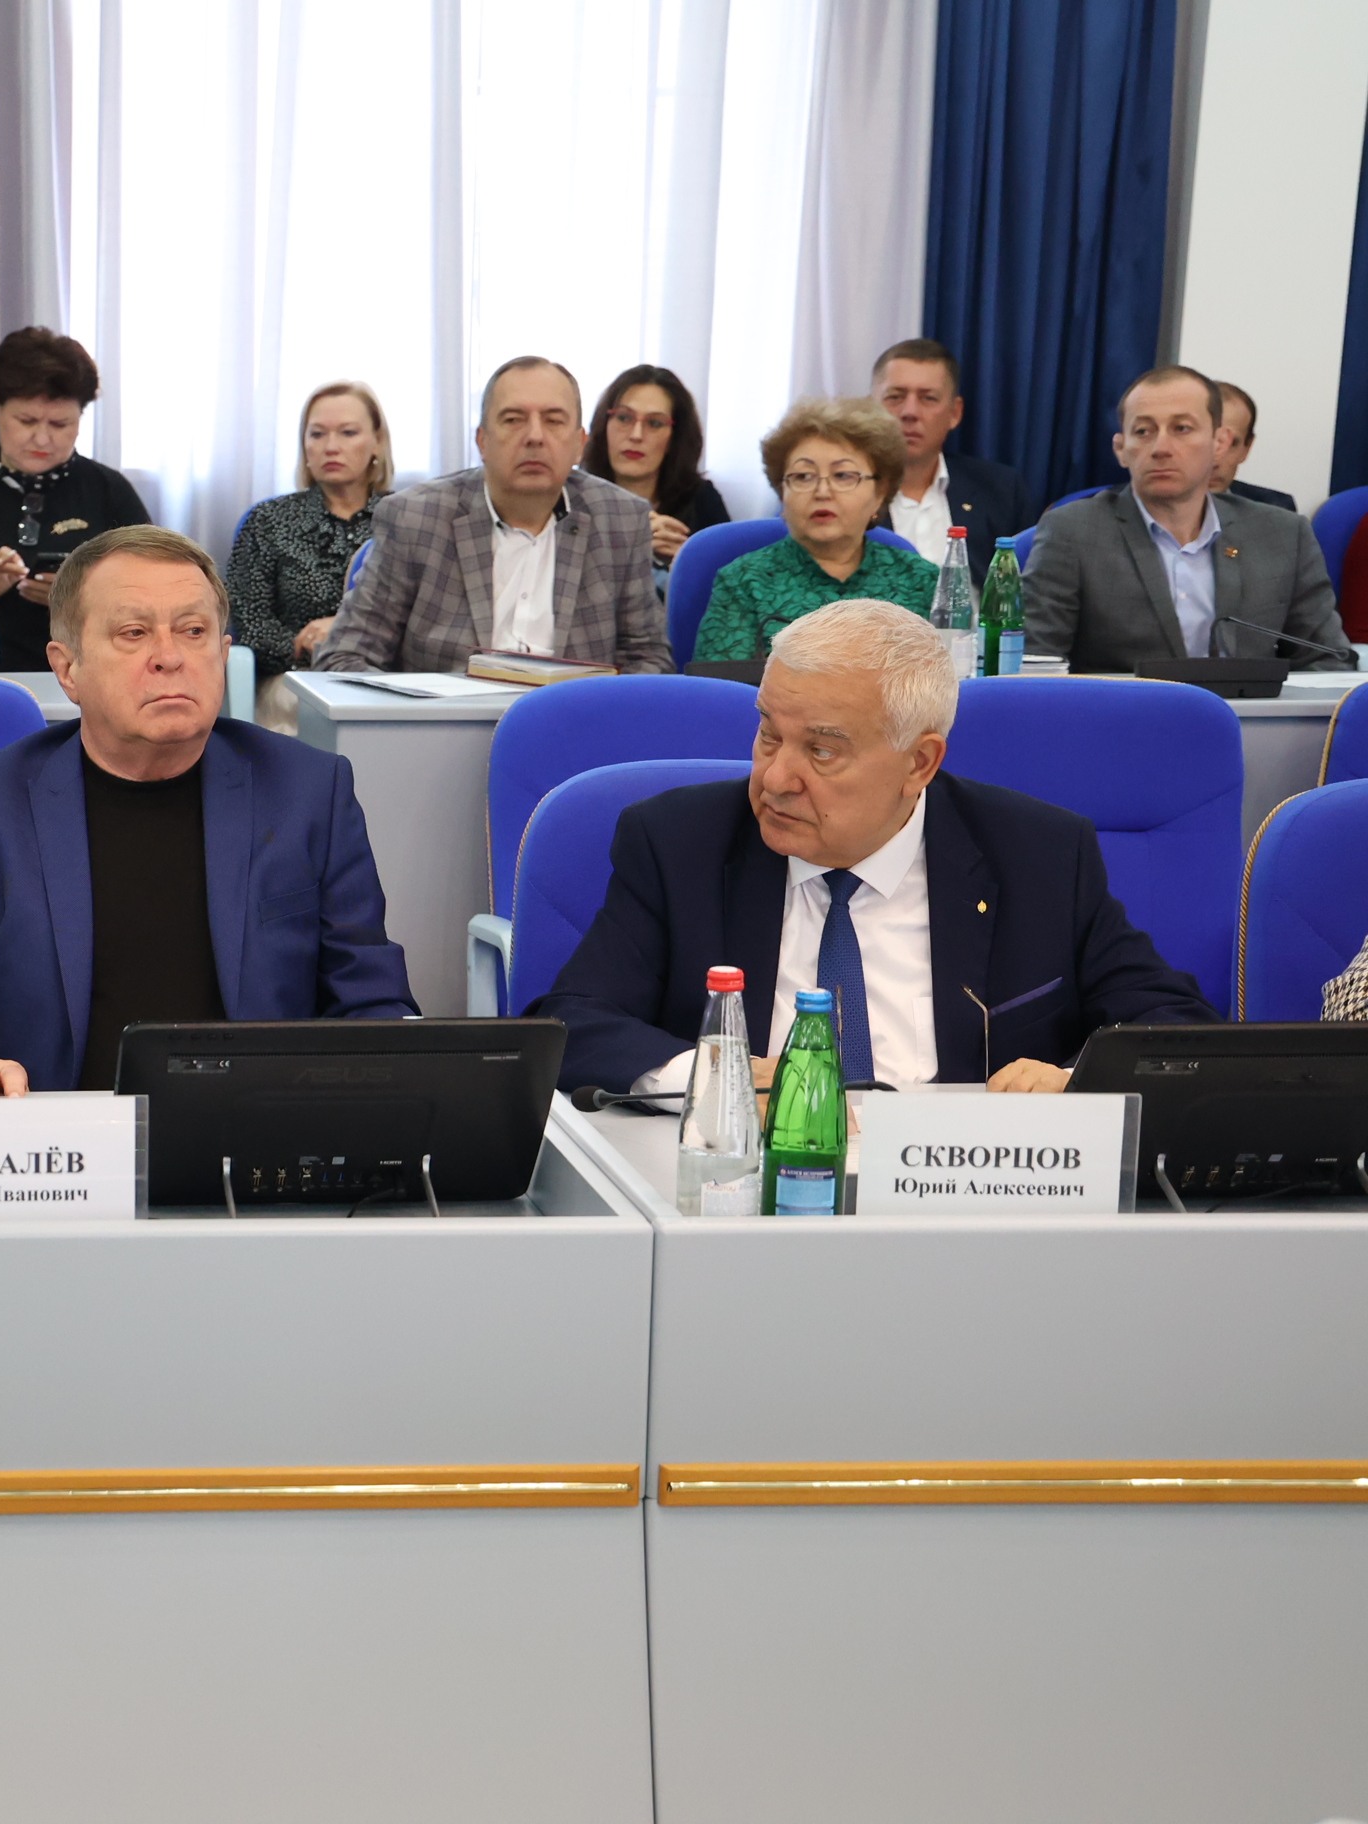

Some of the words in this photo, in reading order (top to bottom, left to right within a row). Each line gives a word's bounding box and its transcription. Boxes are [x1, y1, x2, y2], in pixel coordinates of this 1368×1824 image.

[292, 1067, 392, 1083] ASUS
[900, 1144, 1081, 1174] СКВОРЦОВ
[894, 1177, 957, 1198] Юрий
[964, 1179, 1084, 1196] Алексеевич
